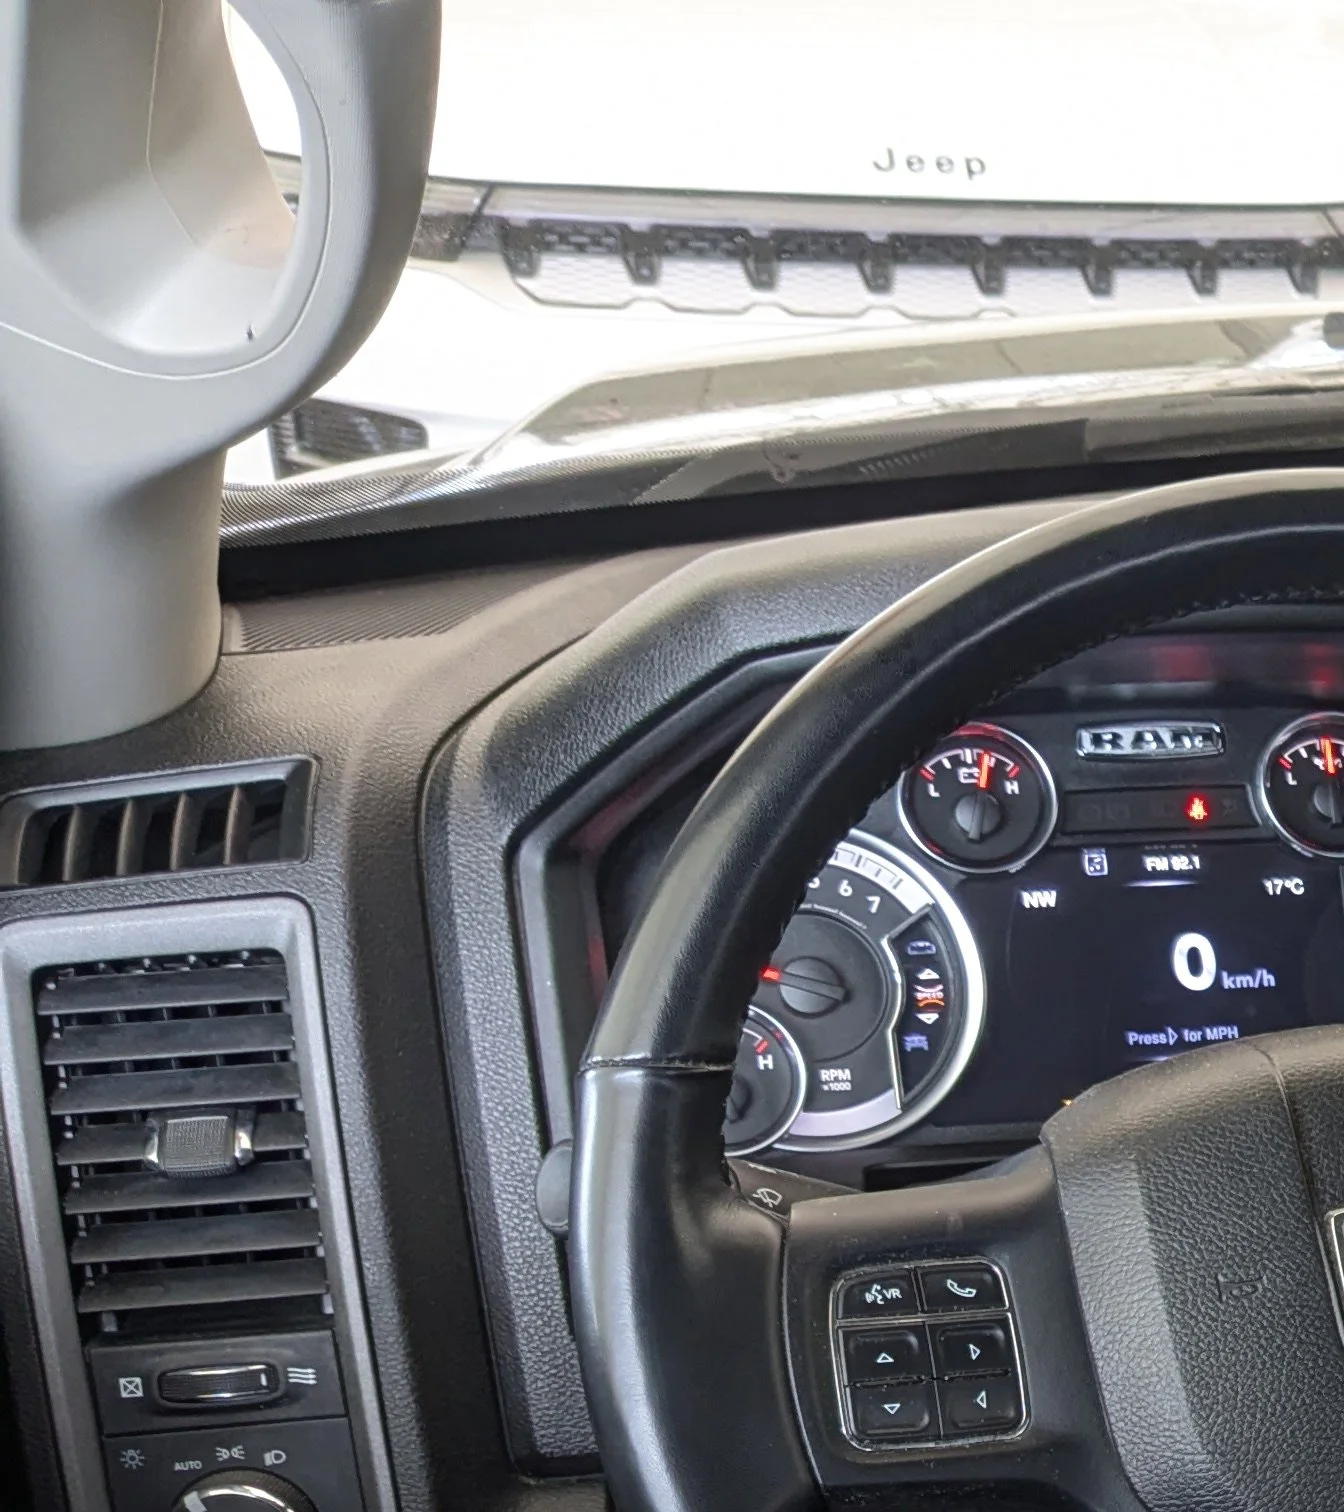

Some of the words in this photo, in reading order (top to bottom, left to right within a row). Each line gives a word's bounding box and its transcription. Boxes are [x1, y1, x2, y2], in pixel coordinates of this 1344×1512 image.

[872, 147, 986, 180] Jeep
[1090, 729, 1212, 751] RAM
[928, 783, 941, 797] L
[1004, 780, 1019, 795] H
[1144, 855, 1169, 871] FM
[839, 879, 853, 897] 6
[865, 895, 881, 914] 7
[1022, 890, 1057, 909] NW
[1170, 931, 1217, 991] 0
[1221, 969, 1276, 991] km/h
[1127, 1029, 1167, 1047] Press
[1183, 1027, 1204, 1043] for
[1206, 1025, 1239, 1042] MPH
[757, 1054, 774, 1070] H
[819, 1068, 852, 1082] RPM
[882, 1287, 902, 1300] VR
[173, 1459, 203, 1472] AUTO
